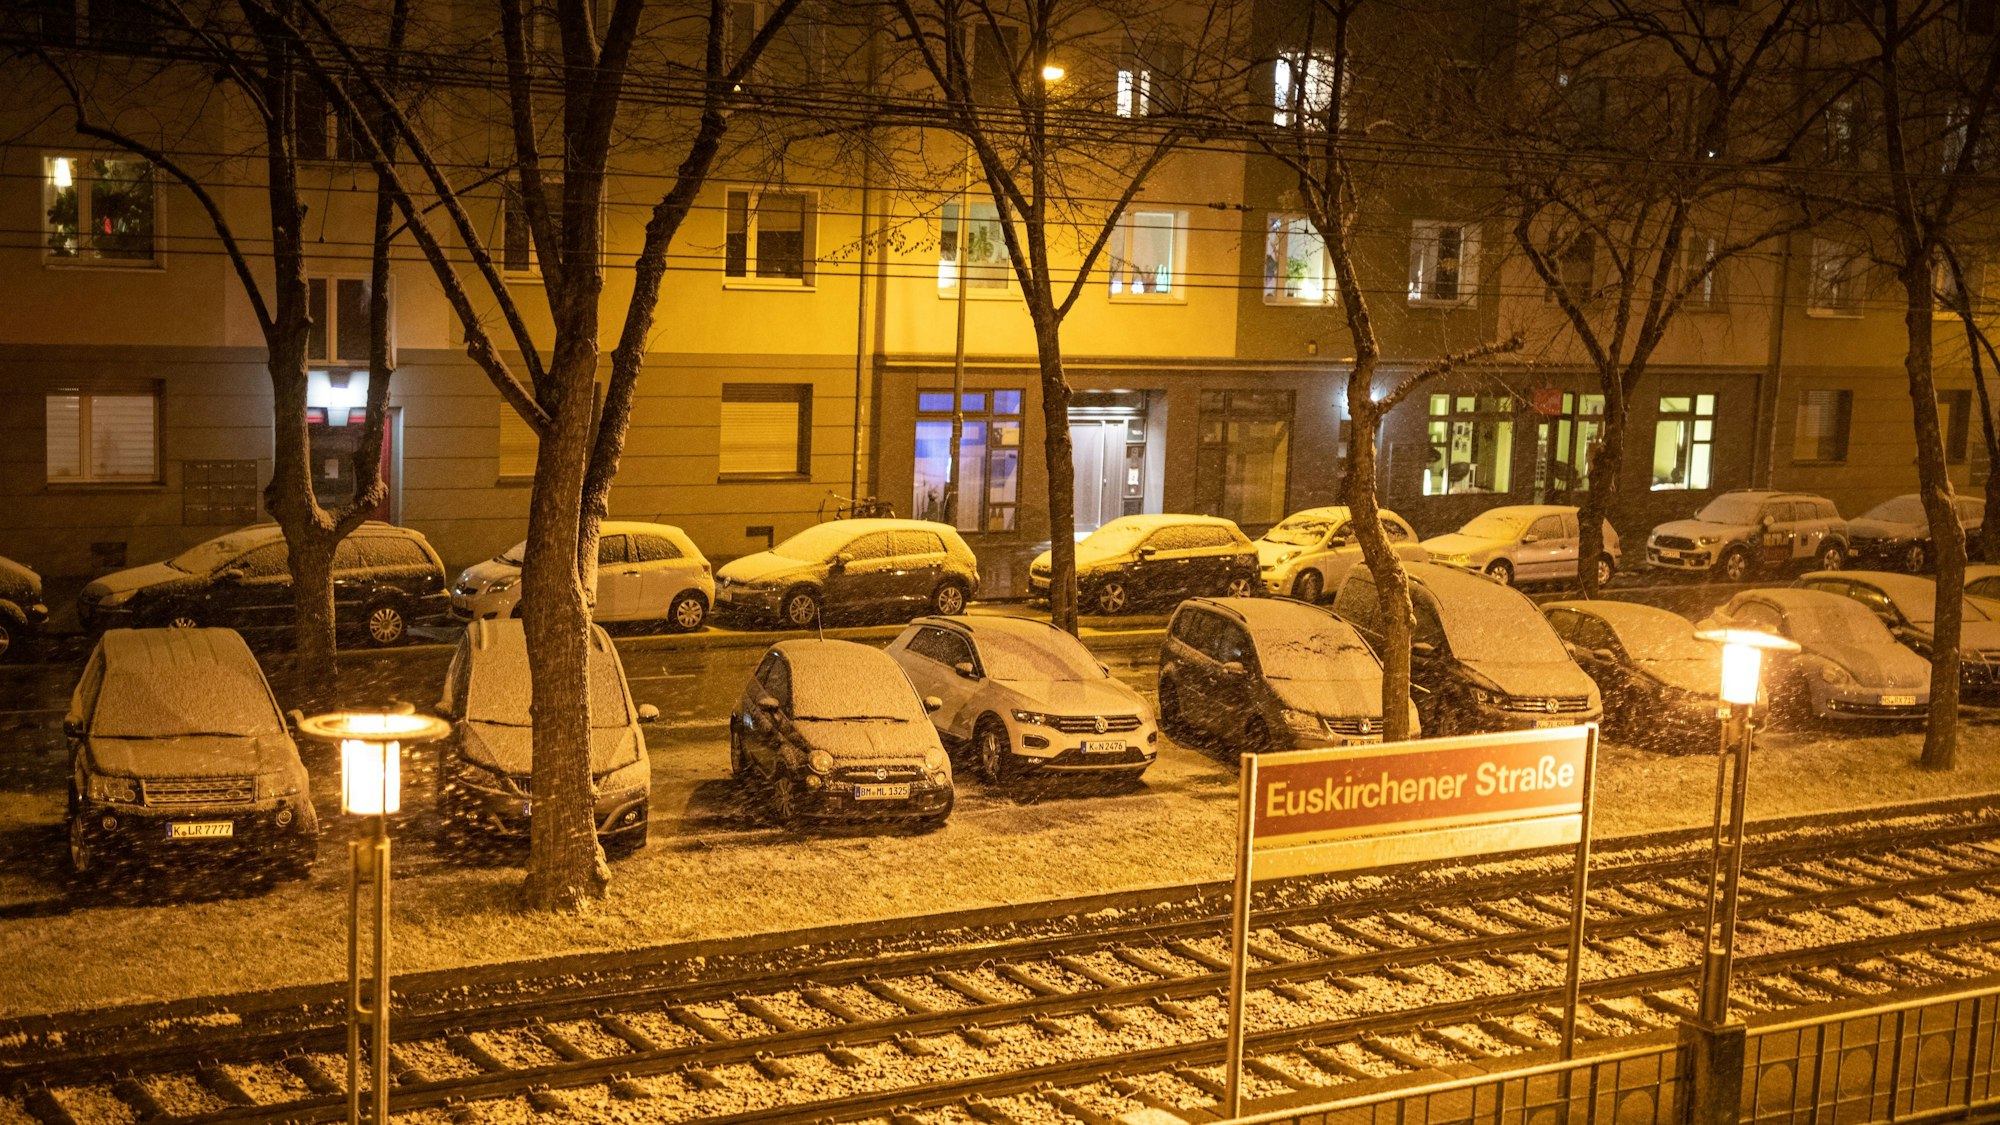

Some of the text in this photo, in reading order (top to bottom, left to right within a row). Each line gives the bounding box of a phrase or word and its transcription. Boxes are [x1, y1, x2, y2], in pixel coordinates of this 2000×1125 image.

[1105, 742, 1123, 751] 2476
[860, 786, 908, 797] BM ML 1325
[1266, 755, 1575, 818] Euskirchener Straße
[173, 824, 231, 836] K LR 7777
